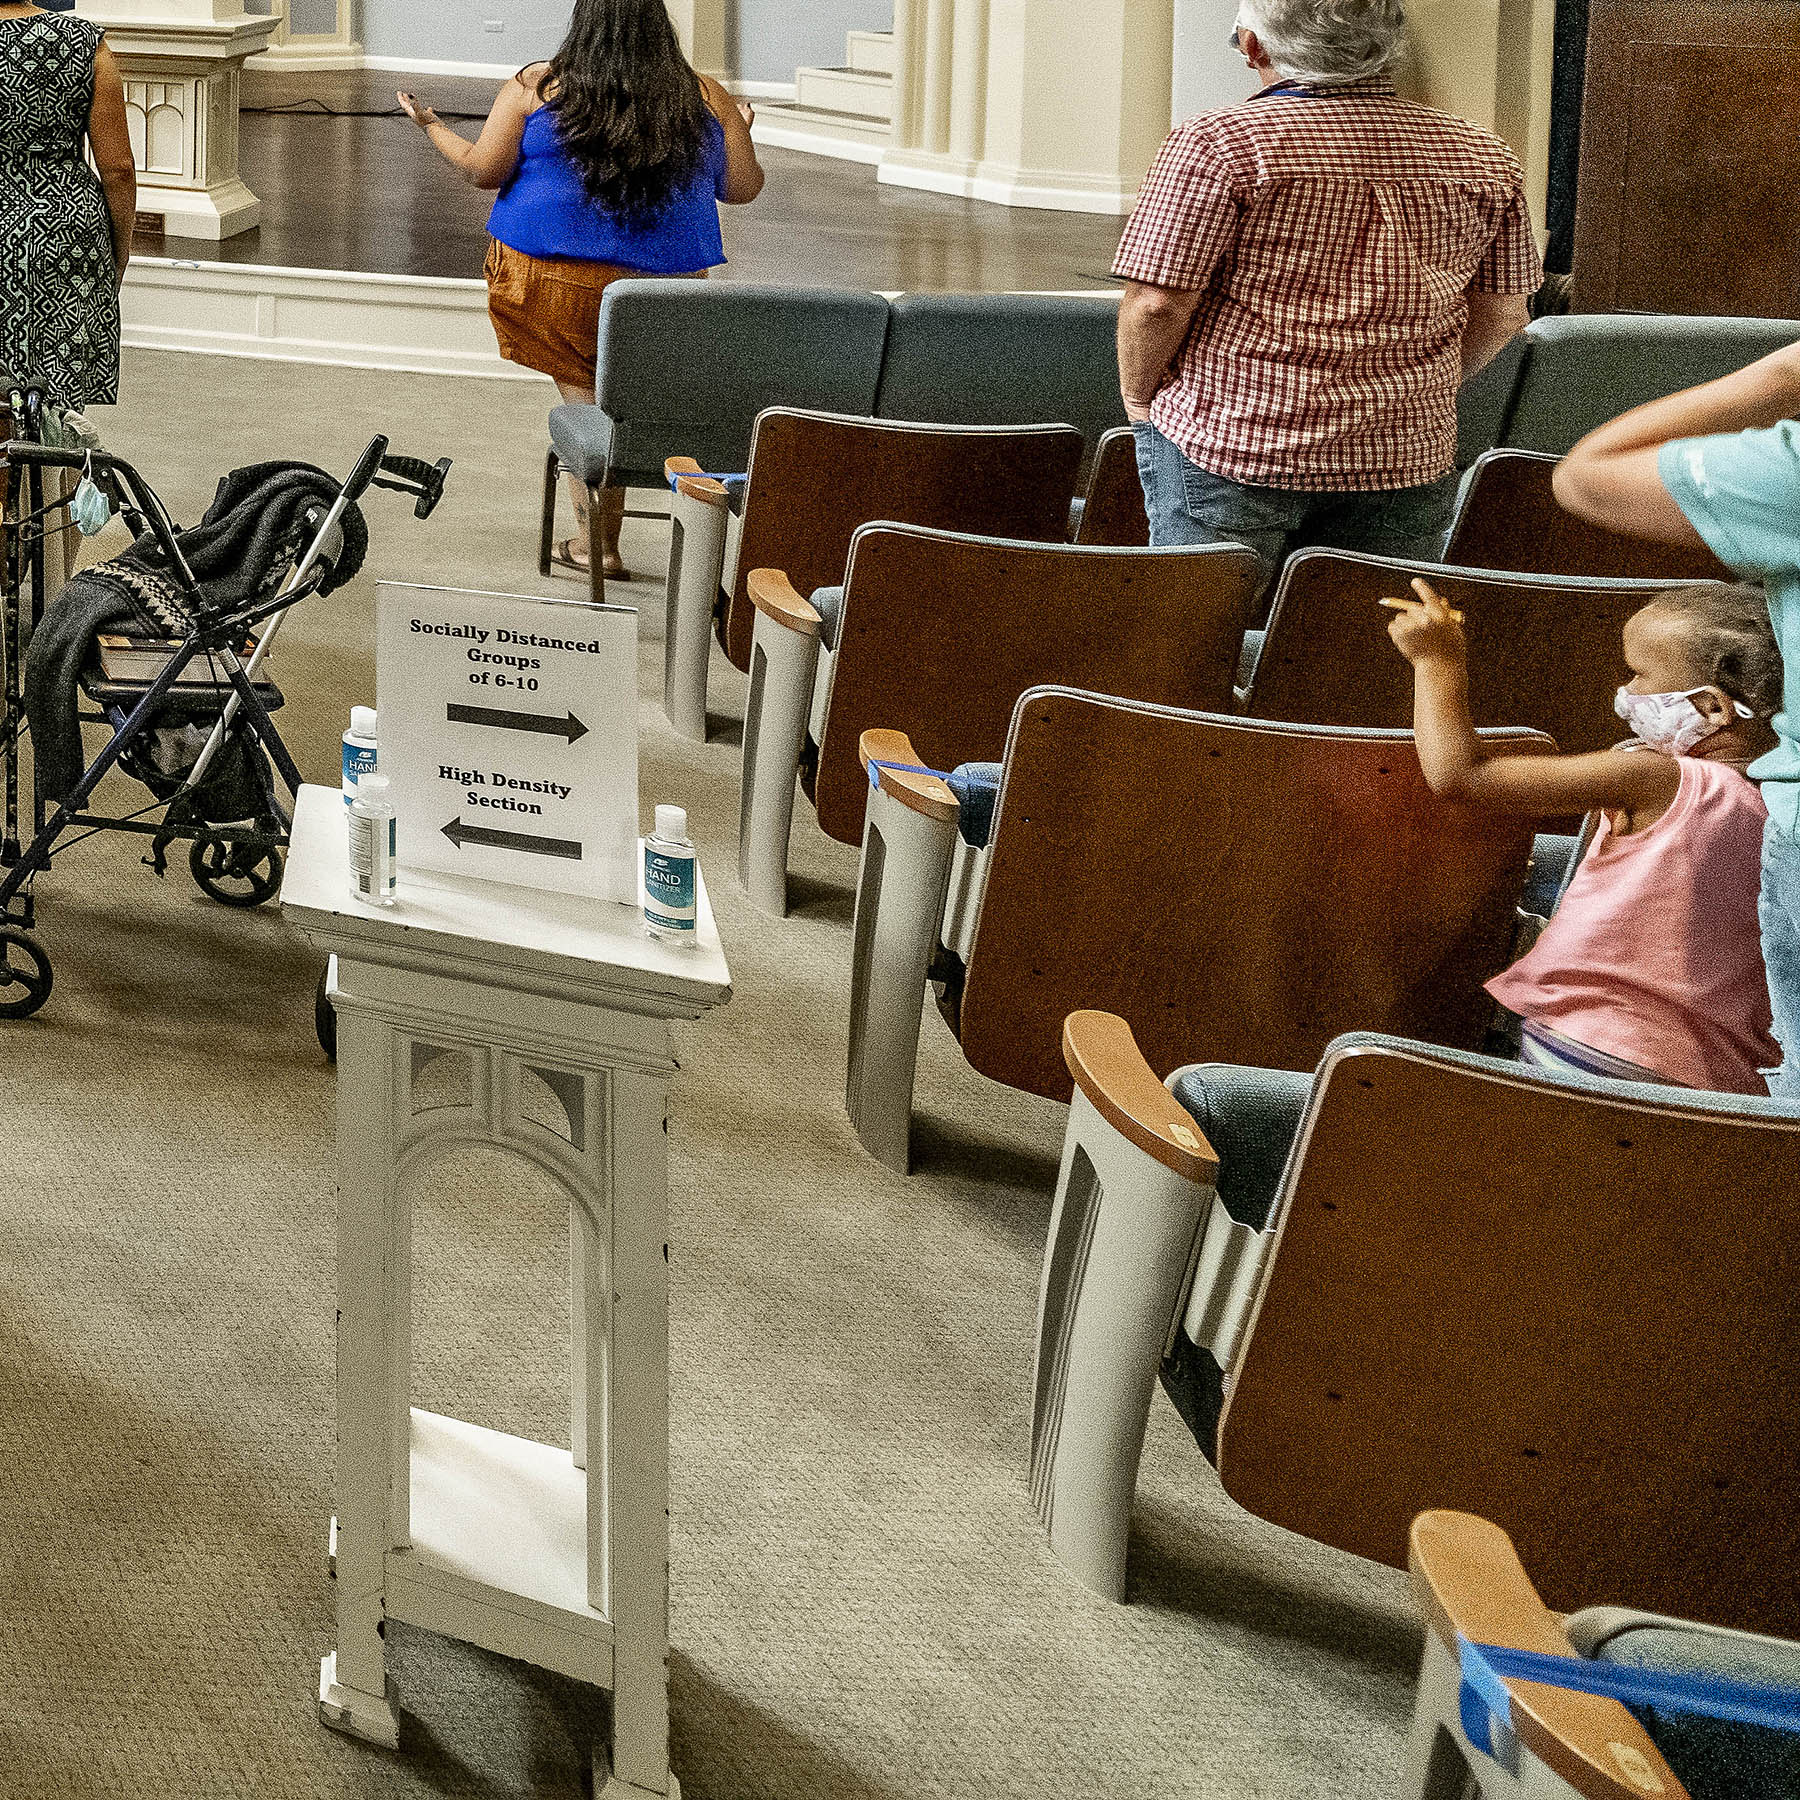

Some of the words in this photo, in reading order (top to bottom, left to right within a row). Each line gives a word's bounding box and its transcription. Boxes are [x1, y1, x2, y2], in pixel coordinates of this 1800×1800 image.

[410, 619, 490, 644] Socially
[496, 628, 601, 654] Distanced
[467, 647, 541, 671] Groups
[469, 671, 491, 686] of
[494, 674, 539, 691] 6-10
[438, 765, 486, 786] High
[491, 772, 572, 800] Density
[467, 791, 543, 815] Section
